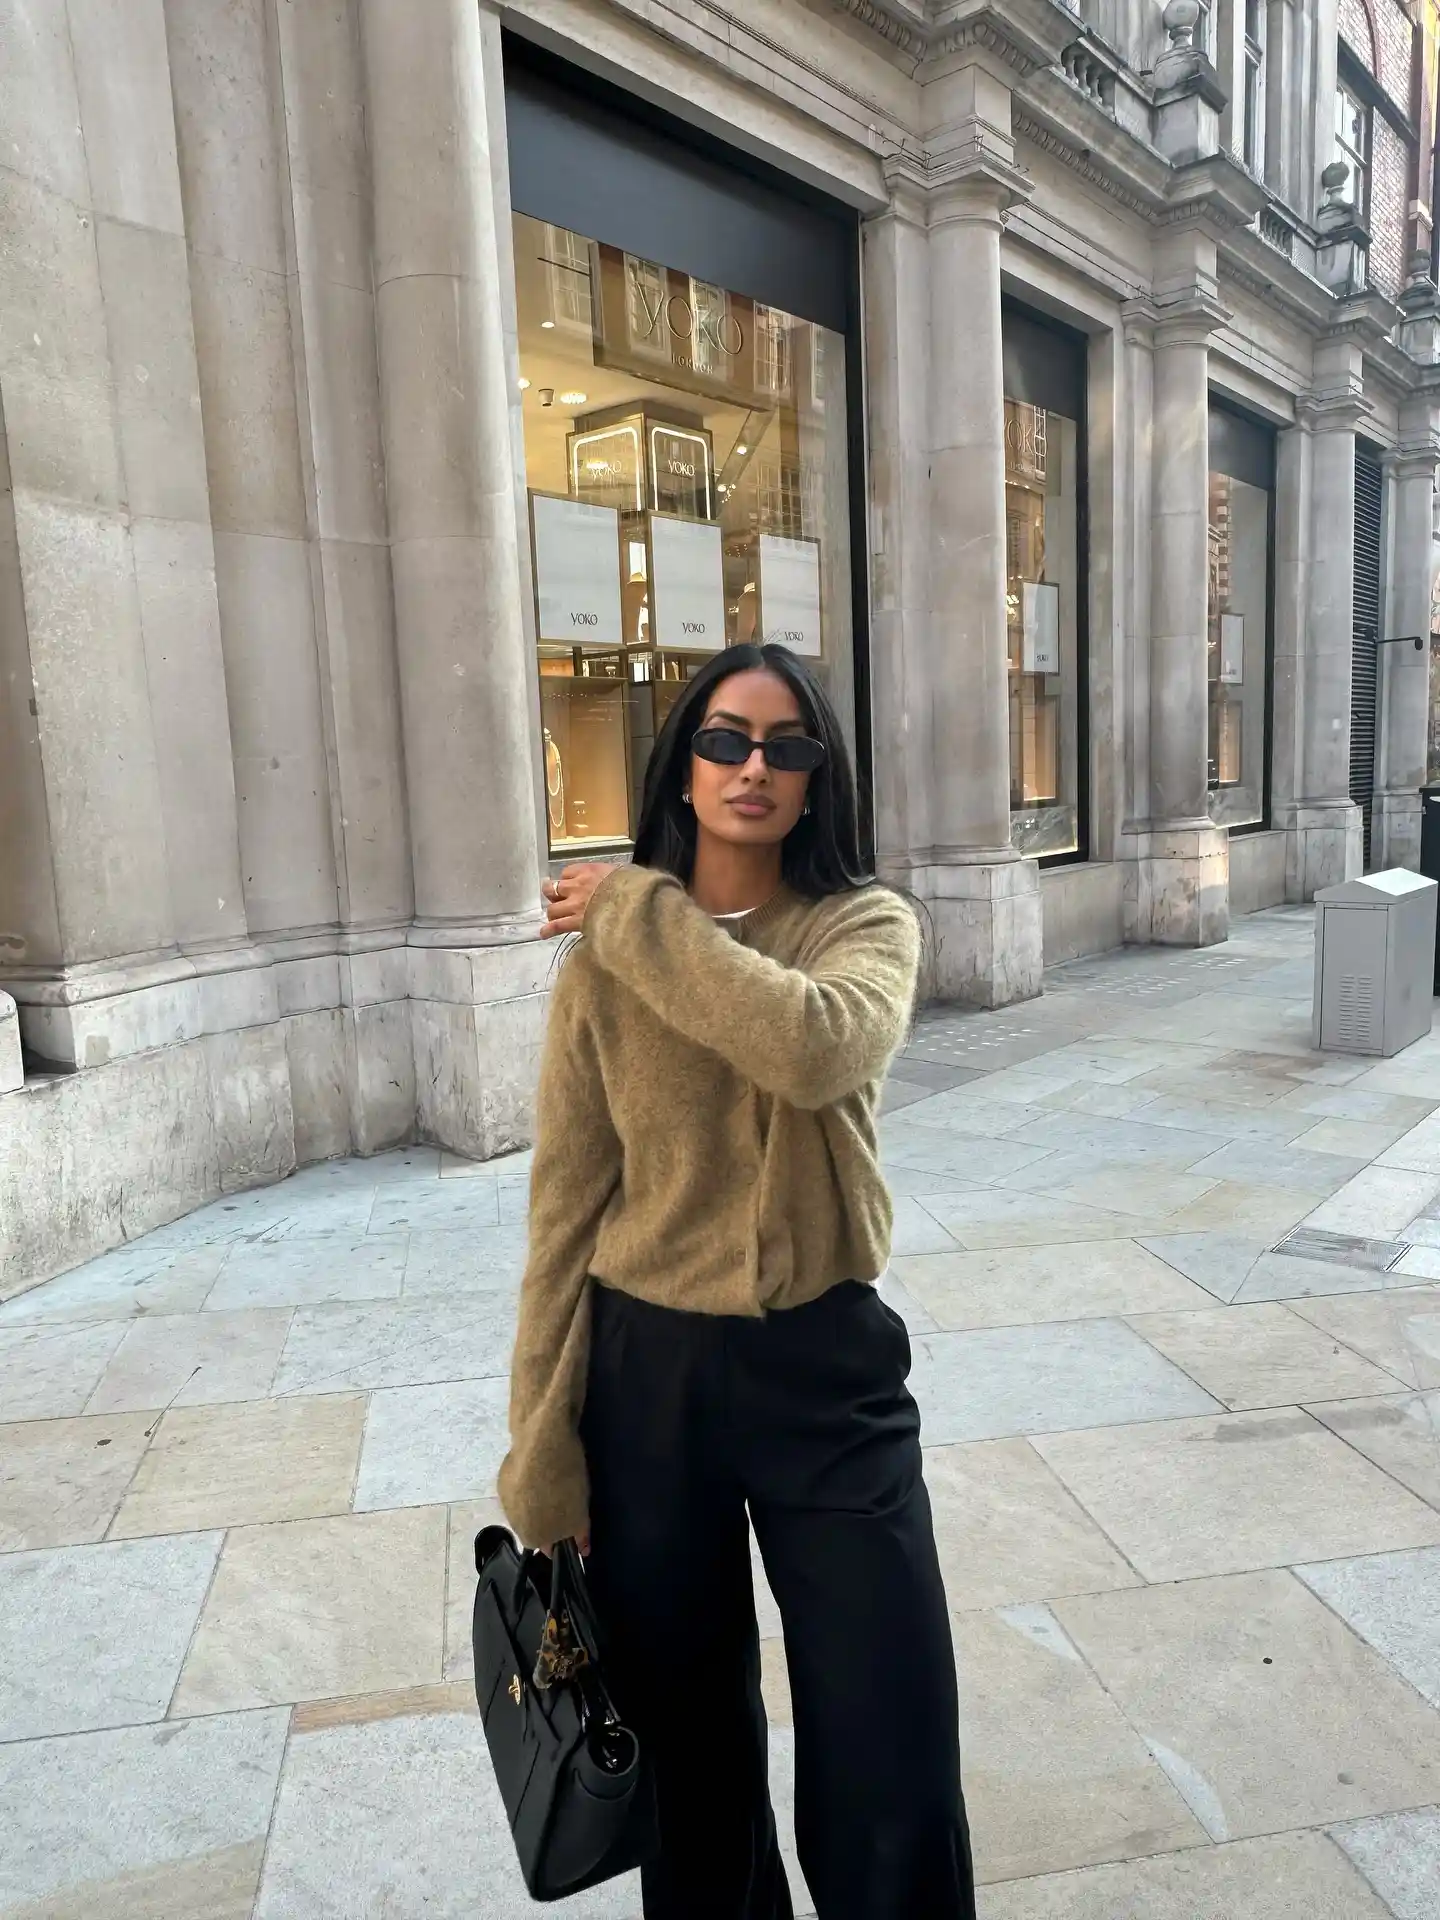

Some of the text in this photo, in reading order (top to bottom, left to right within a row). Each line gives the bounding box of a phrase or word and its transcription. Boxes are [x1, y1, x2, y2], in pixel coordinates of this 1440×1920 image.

[635, 281, 742, 355] YOKO
[668, 459, 695, 476] YOKO
[571, 612, 598, 626] YOKO
[682, 622, 705, 634] YOKO
